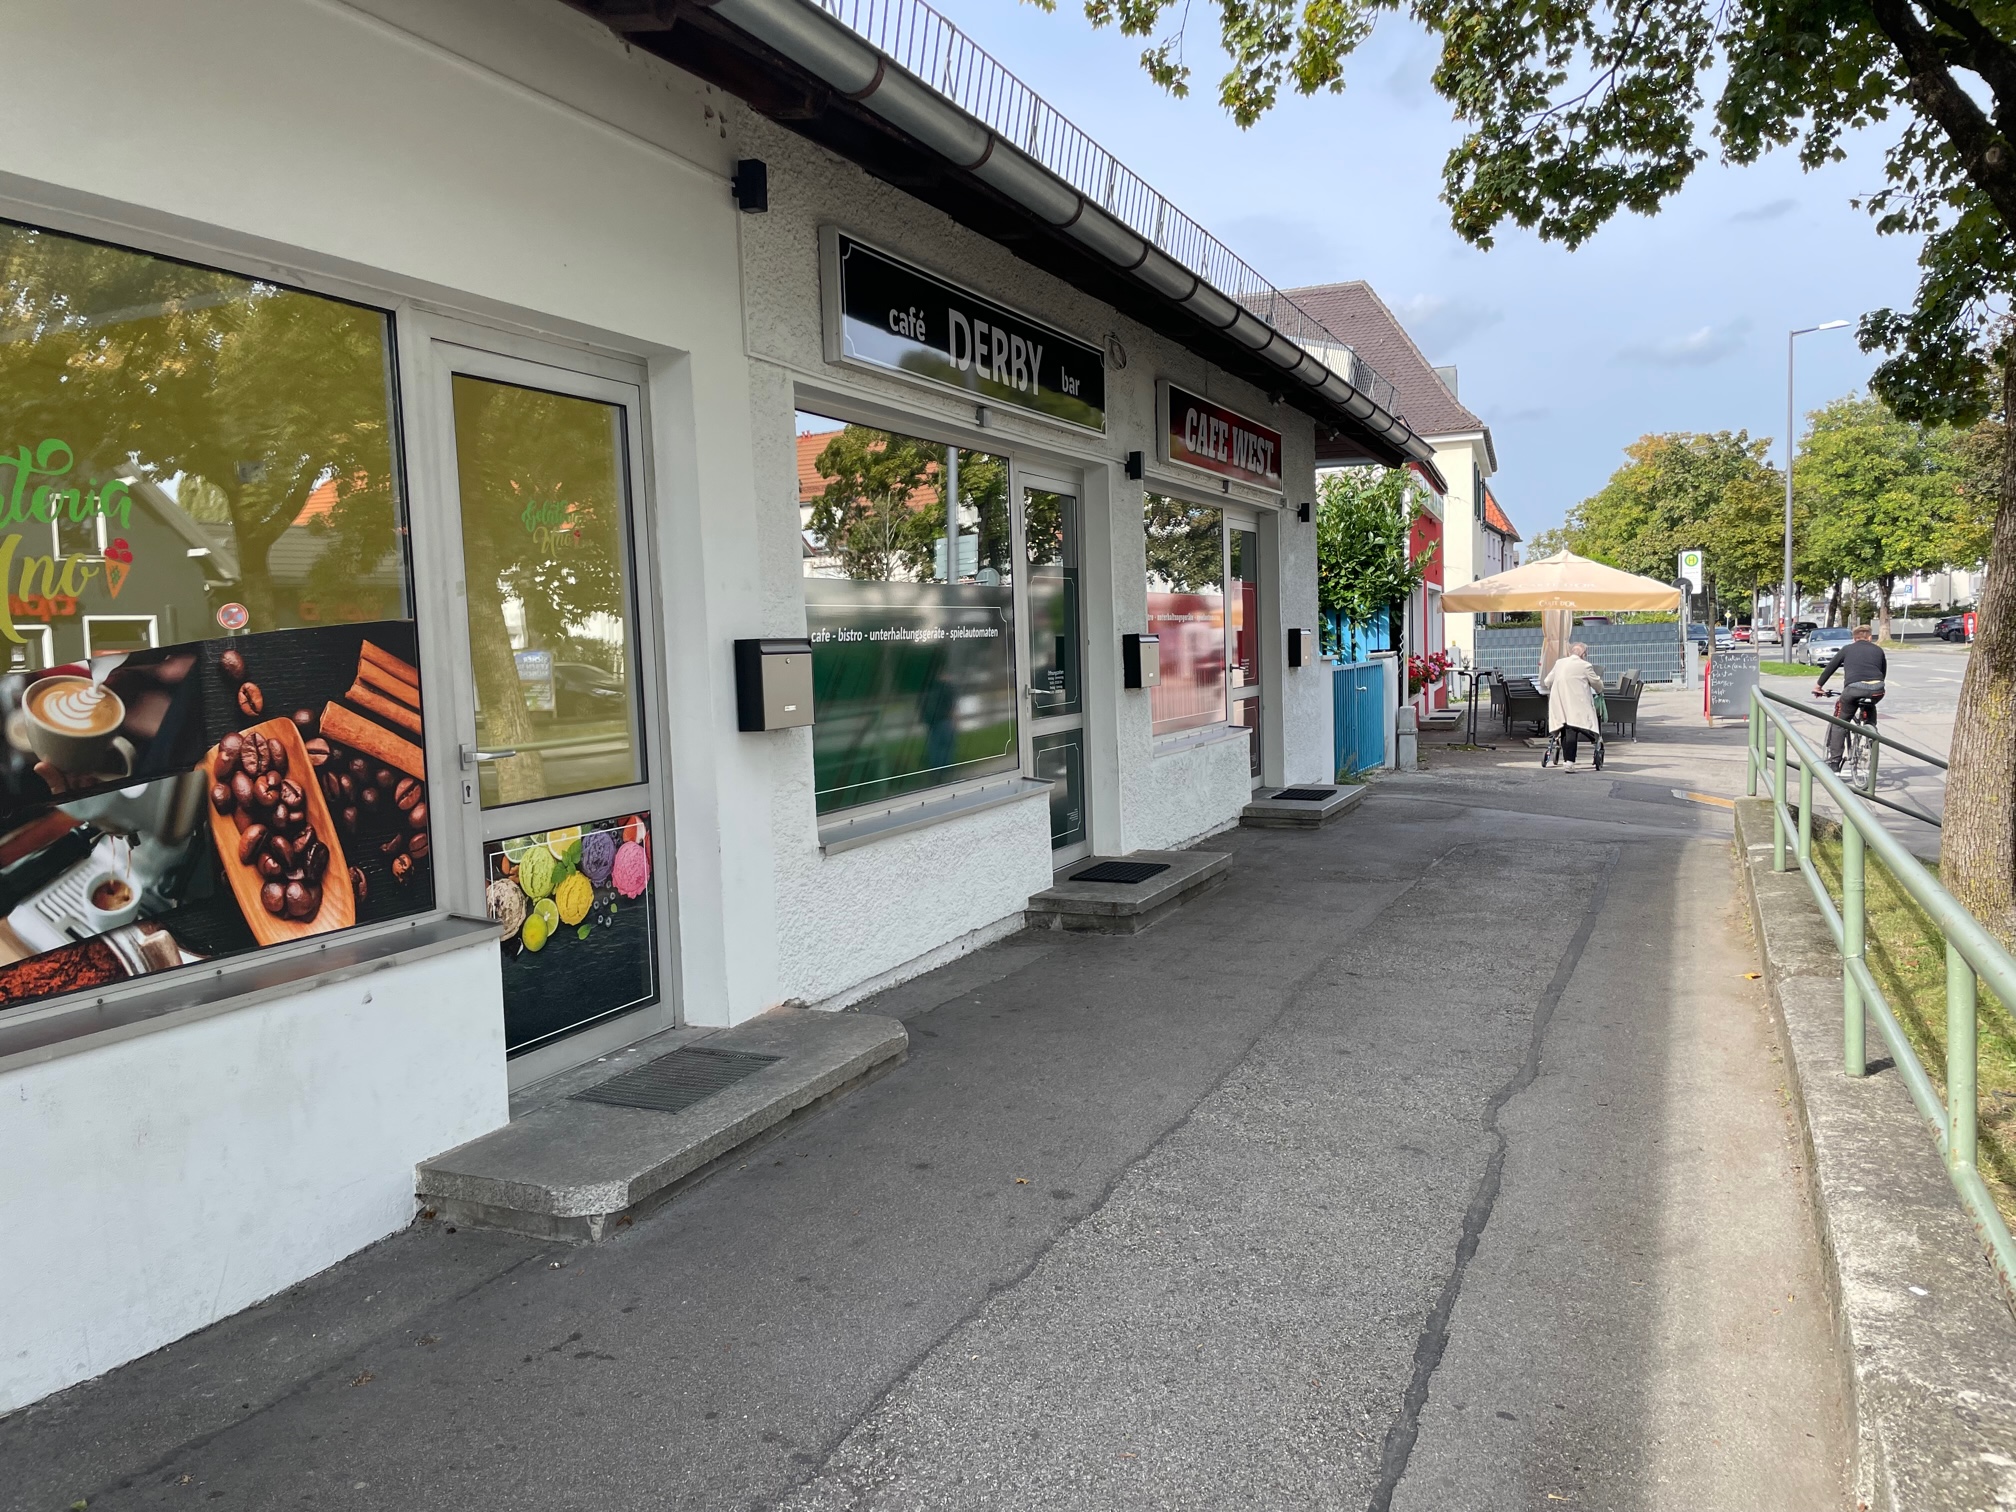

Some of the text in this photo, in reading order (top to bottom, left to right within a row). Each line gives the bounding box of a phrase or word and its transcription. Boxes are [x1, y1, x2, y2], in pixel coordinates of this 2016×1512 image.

[889, 306, 1081, 397] café DERBY bar
[1185, 408, 1275, 477] CAFE WEST
[0, 438, 131, 529] teria
[811, 628, 831, 643] cafe
[838, 627, 863, 642] bistro
[869, 626, 945, 644] unterhaltungsgeräte
[950, 625, 999, 641] spielautomaten
